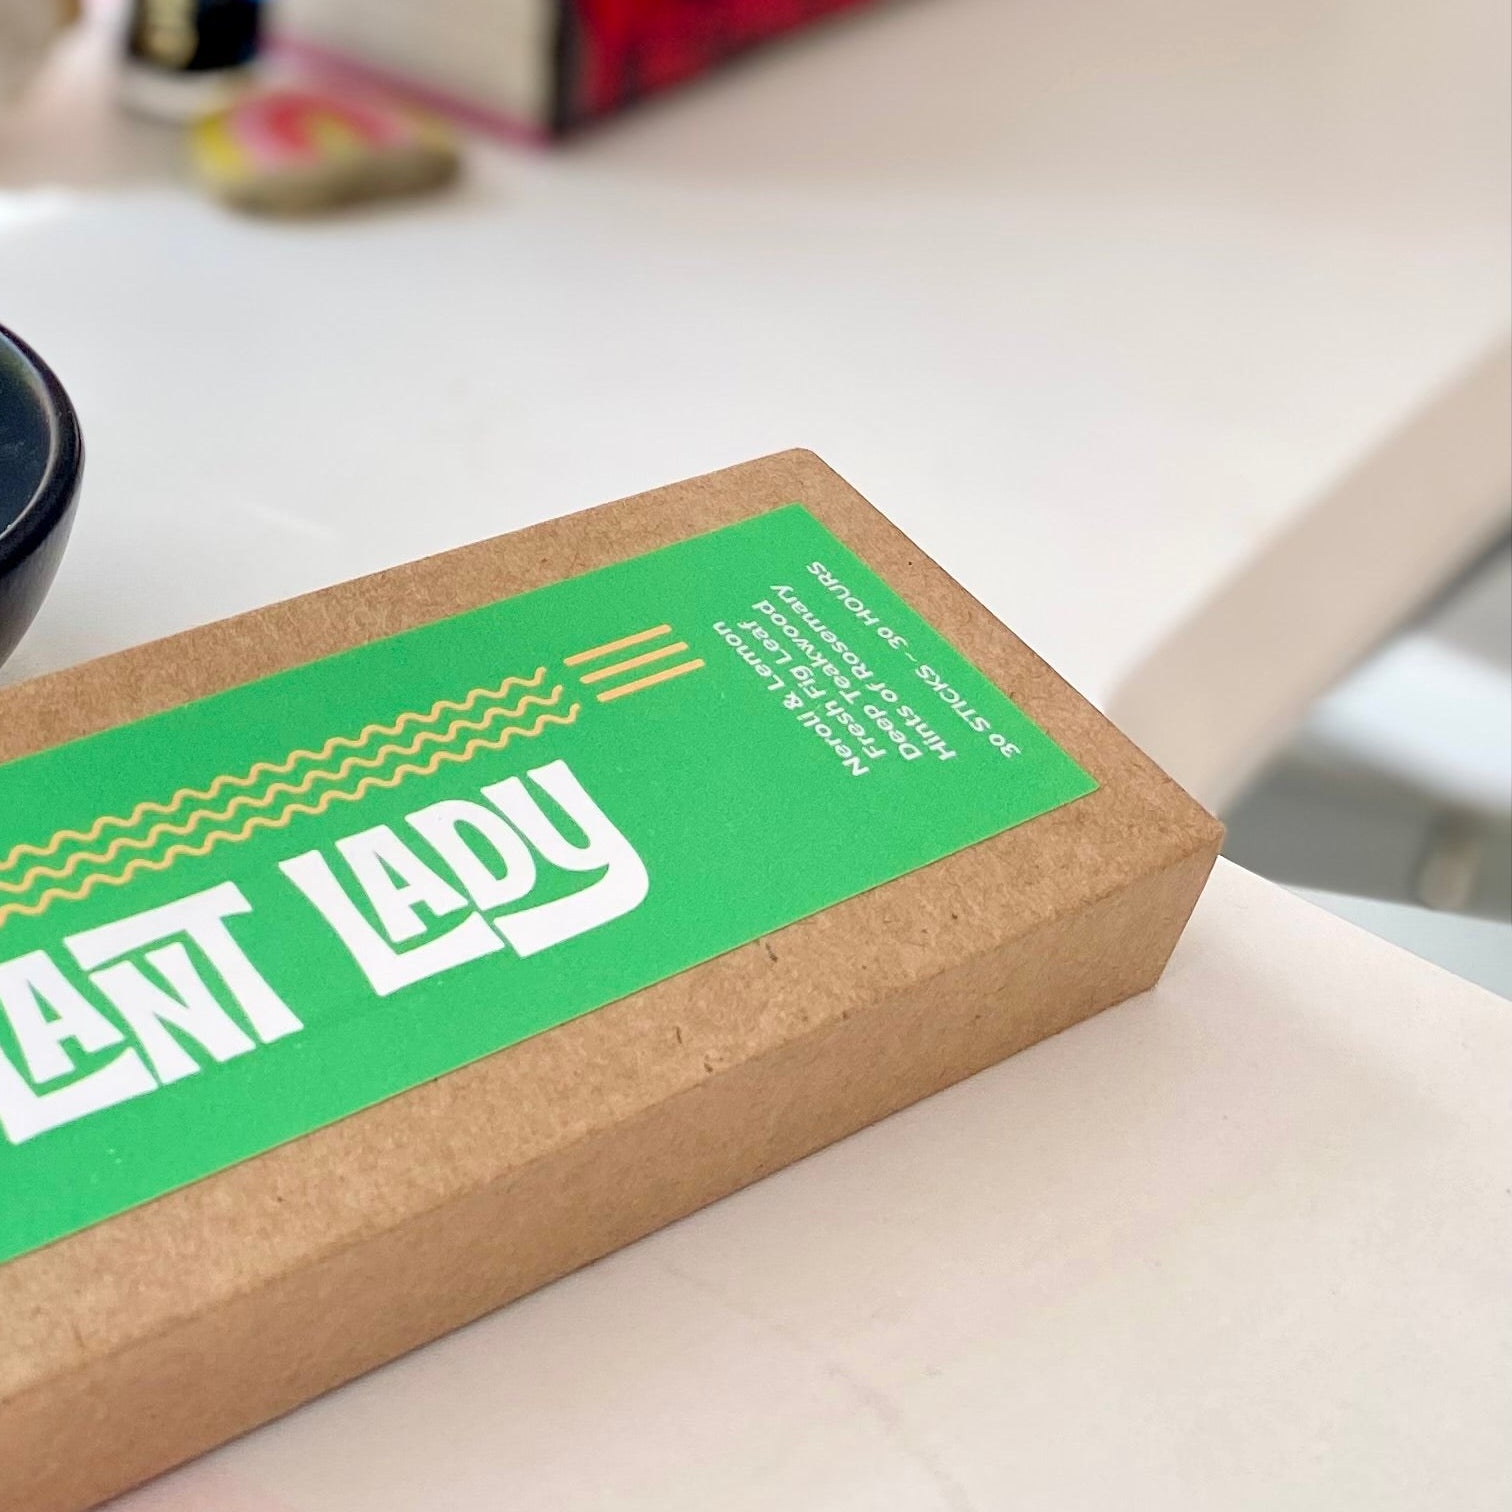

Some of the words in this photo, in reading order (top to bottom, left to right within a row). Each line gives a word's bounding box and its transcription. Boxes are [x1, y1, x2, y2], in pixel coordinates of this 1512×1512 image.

[805, 561, 880, 626] HOURS
[712, 621, 785, 692] Lemon
[737, 620, 793, 664] Leaf
[752, 599, 862, 705] Teakwood
[770, 585, 874, 680] Rosemary
[877, 626, 908, 650] 30
[782, 691, 804, 710] &
[789, 665, 827, 699] Fig
[865, 682, 899, 703] of
[915, 664, 991, 732] STICKS
[796, 711, 870, 776] Neroli
[825, 700, 887, 759] Fresh
[863, 704, 923, 761] Deep
[896, 705, 957, 761] Hints
[988, 733, 1022, 759] 30
[279, 758, 651, 998] LADY
